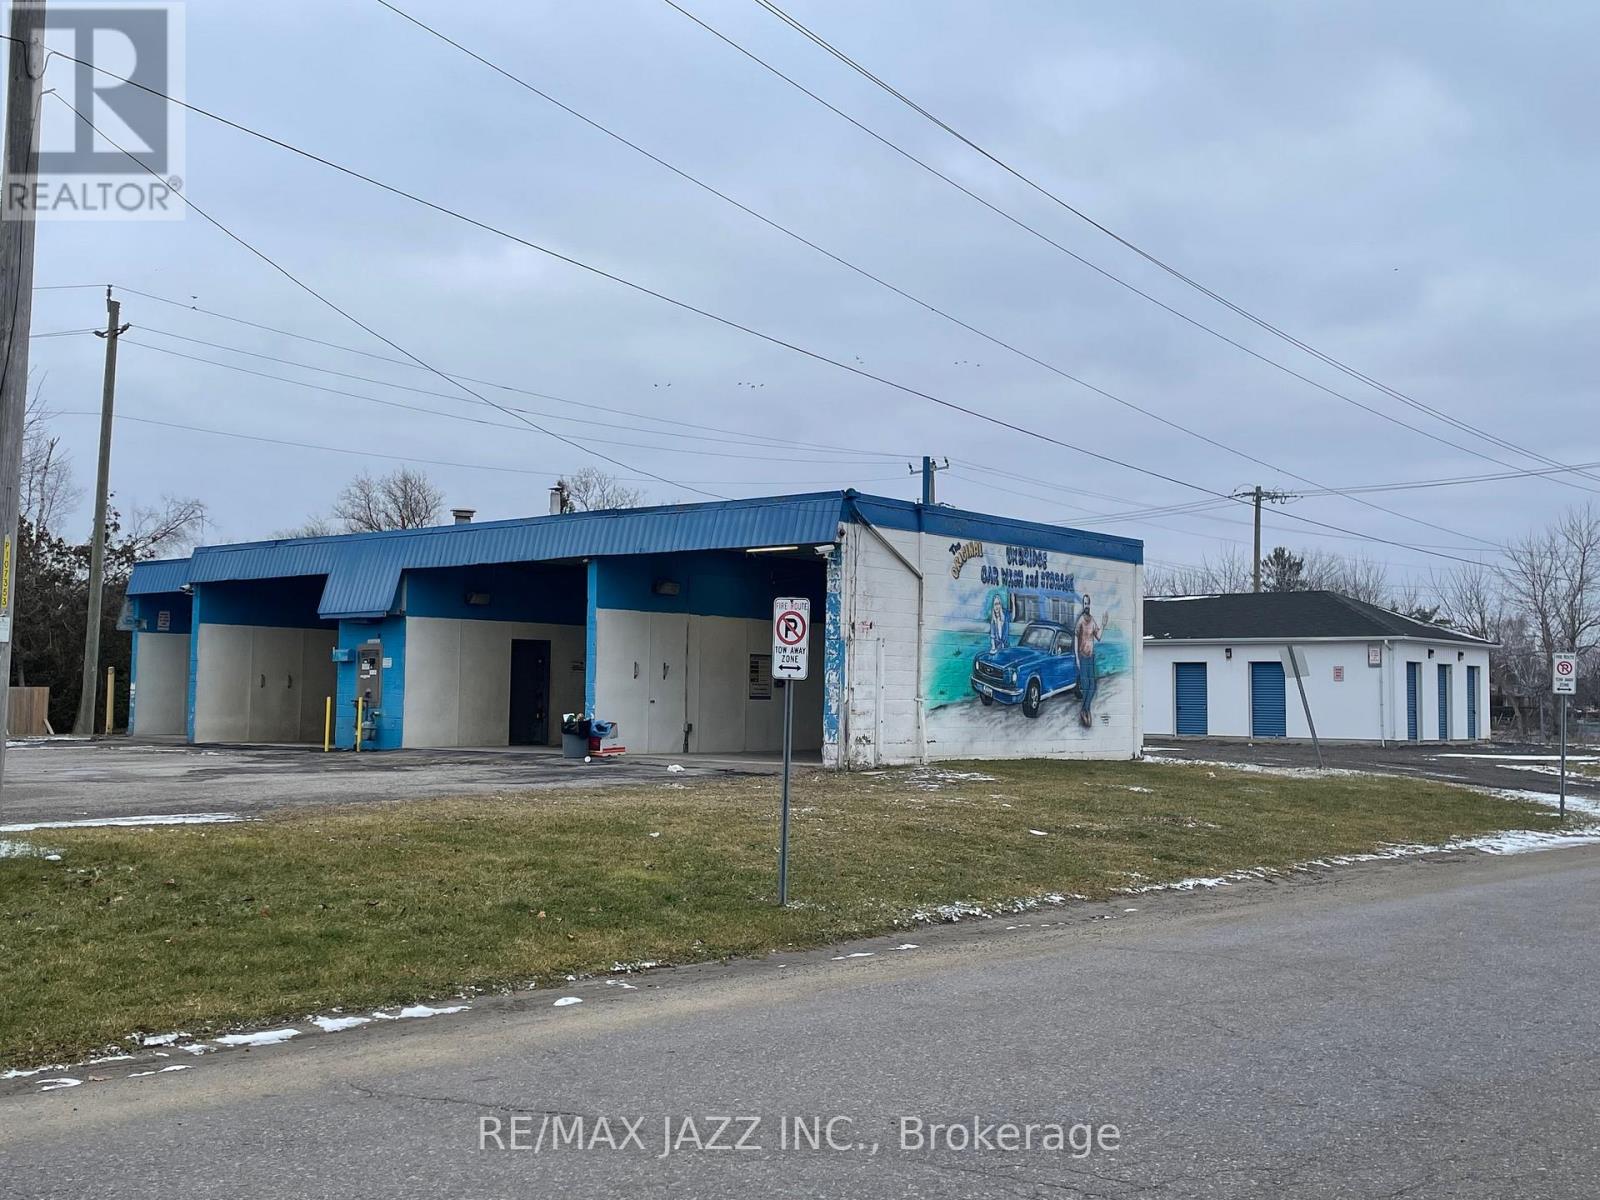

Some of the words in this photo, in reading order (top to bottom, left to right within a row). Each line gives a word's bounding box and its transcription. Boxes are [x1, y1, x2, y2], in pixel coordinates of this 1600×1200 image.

[980, 564, 999, 586] CAR
[775, 646, 787, 654] TOW
[789, 646, 806, 655] AWAY
[781, 654, 799, 663] ZONE
